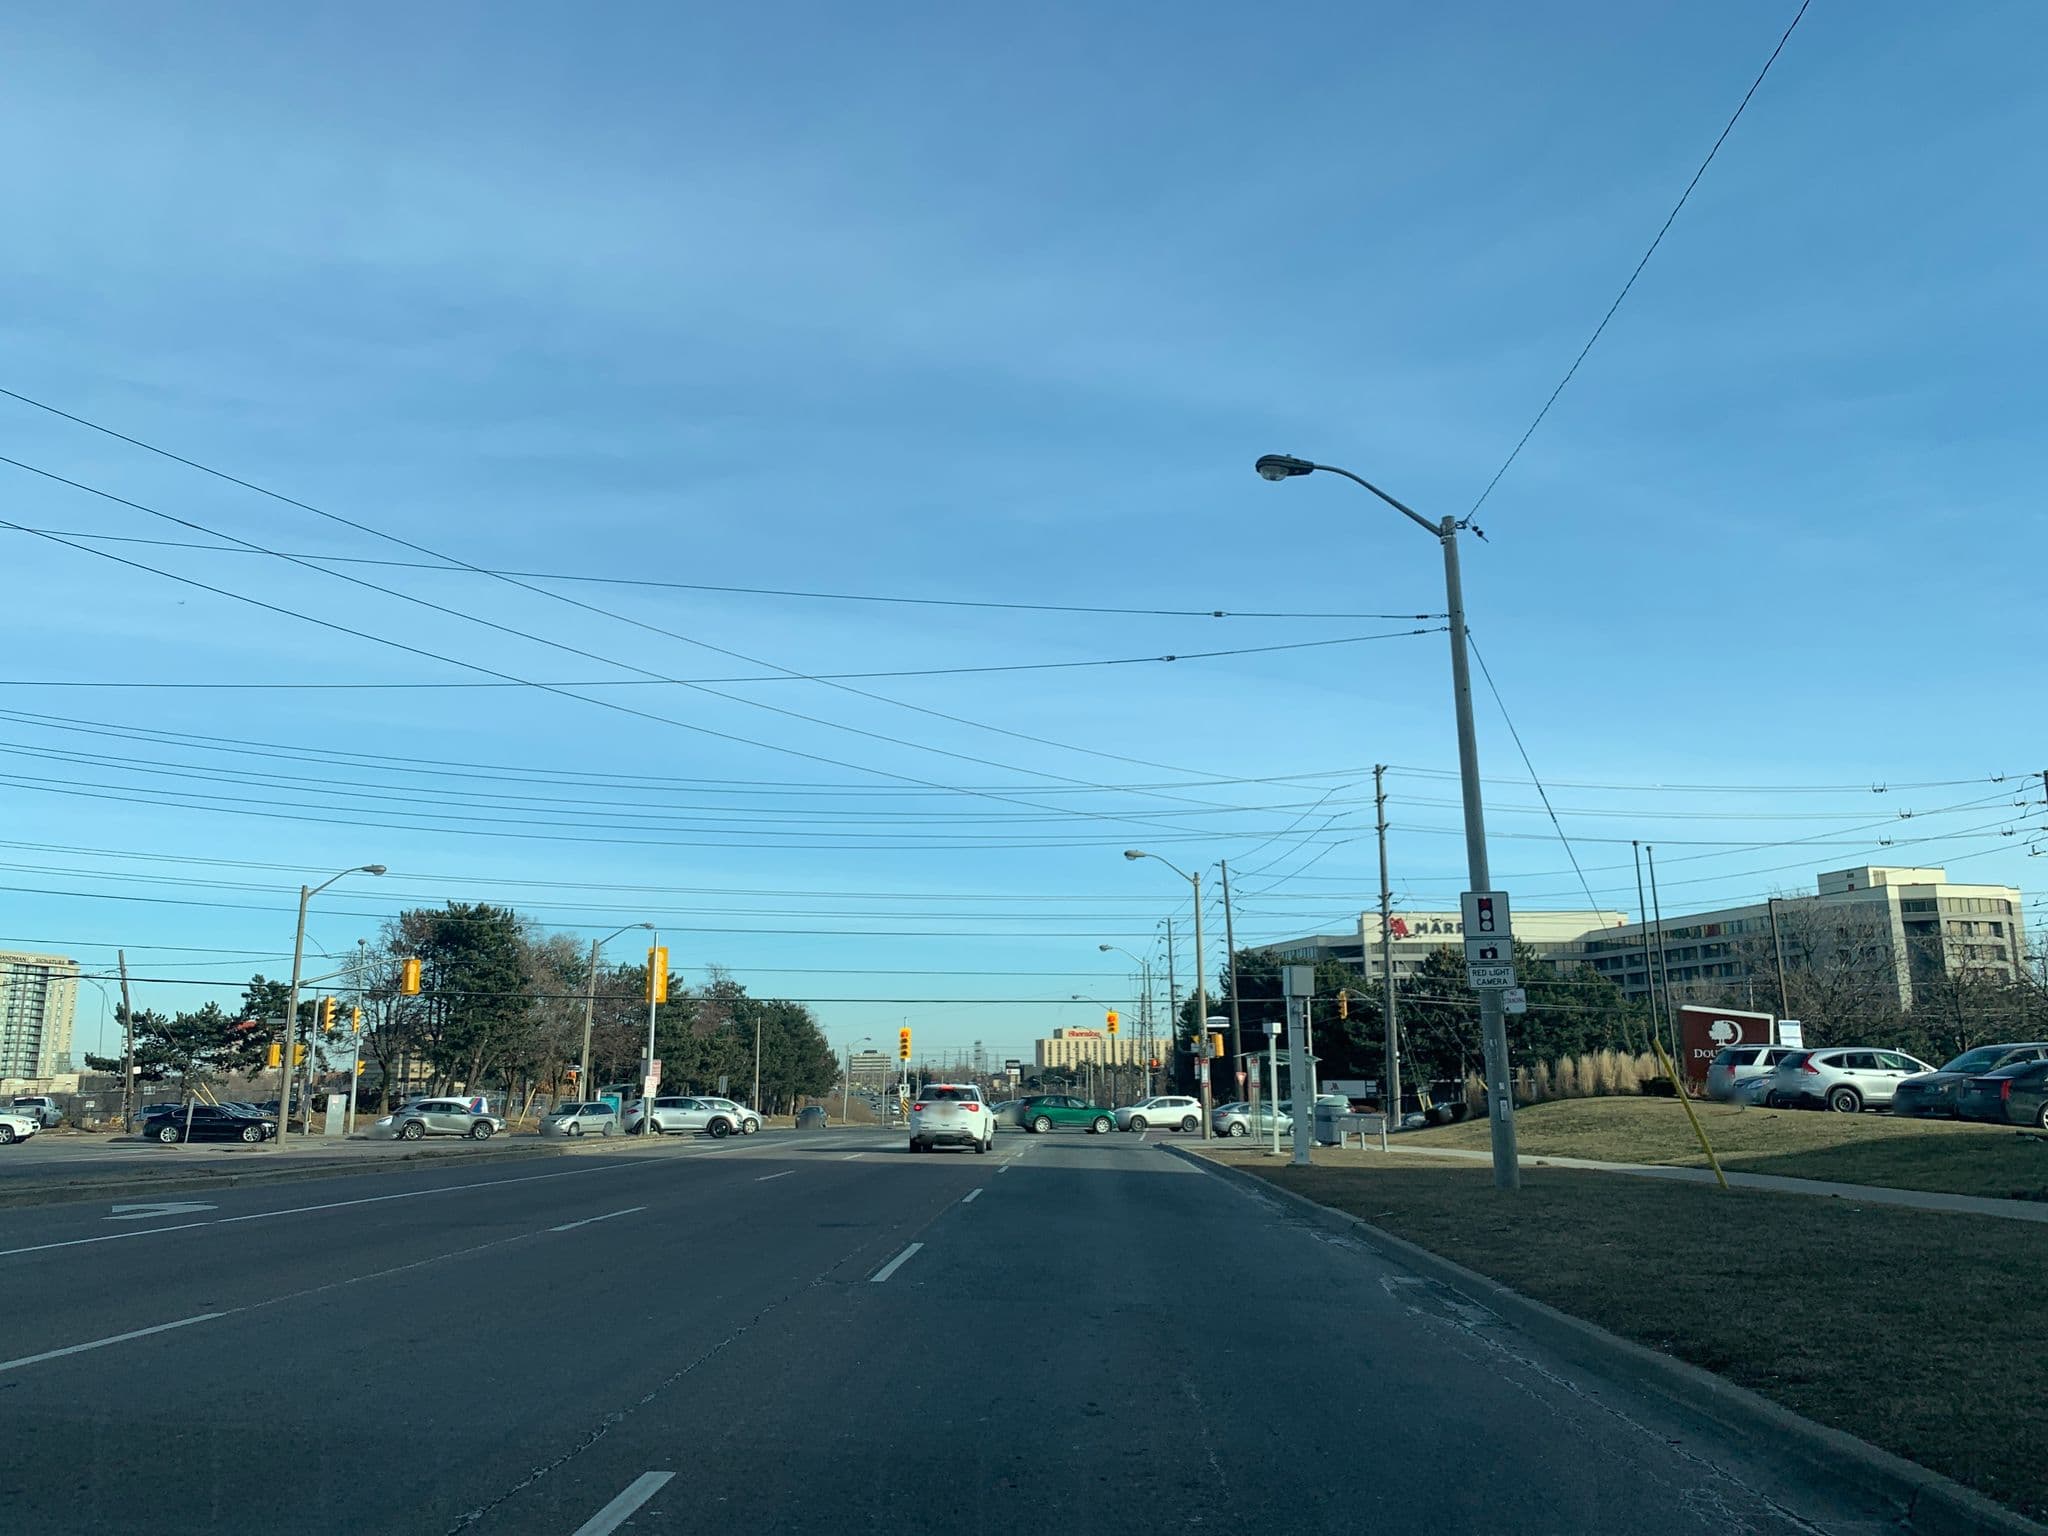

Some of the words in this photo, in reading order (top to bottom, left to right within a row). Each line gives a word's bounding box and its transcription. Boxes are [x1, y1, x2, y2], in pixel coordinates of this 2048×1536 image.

[1472, 969, 1487, 977] RED
[1490, 968, 1510, 976] LIGHT
[1477, 978, 1508, 986] CAMERA
